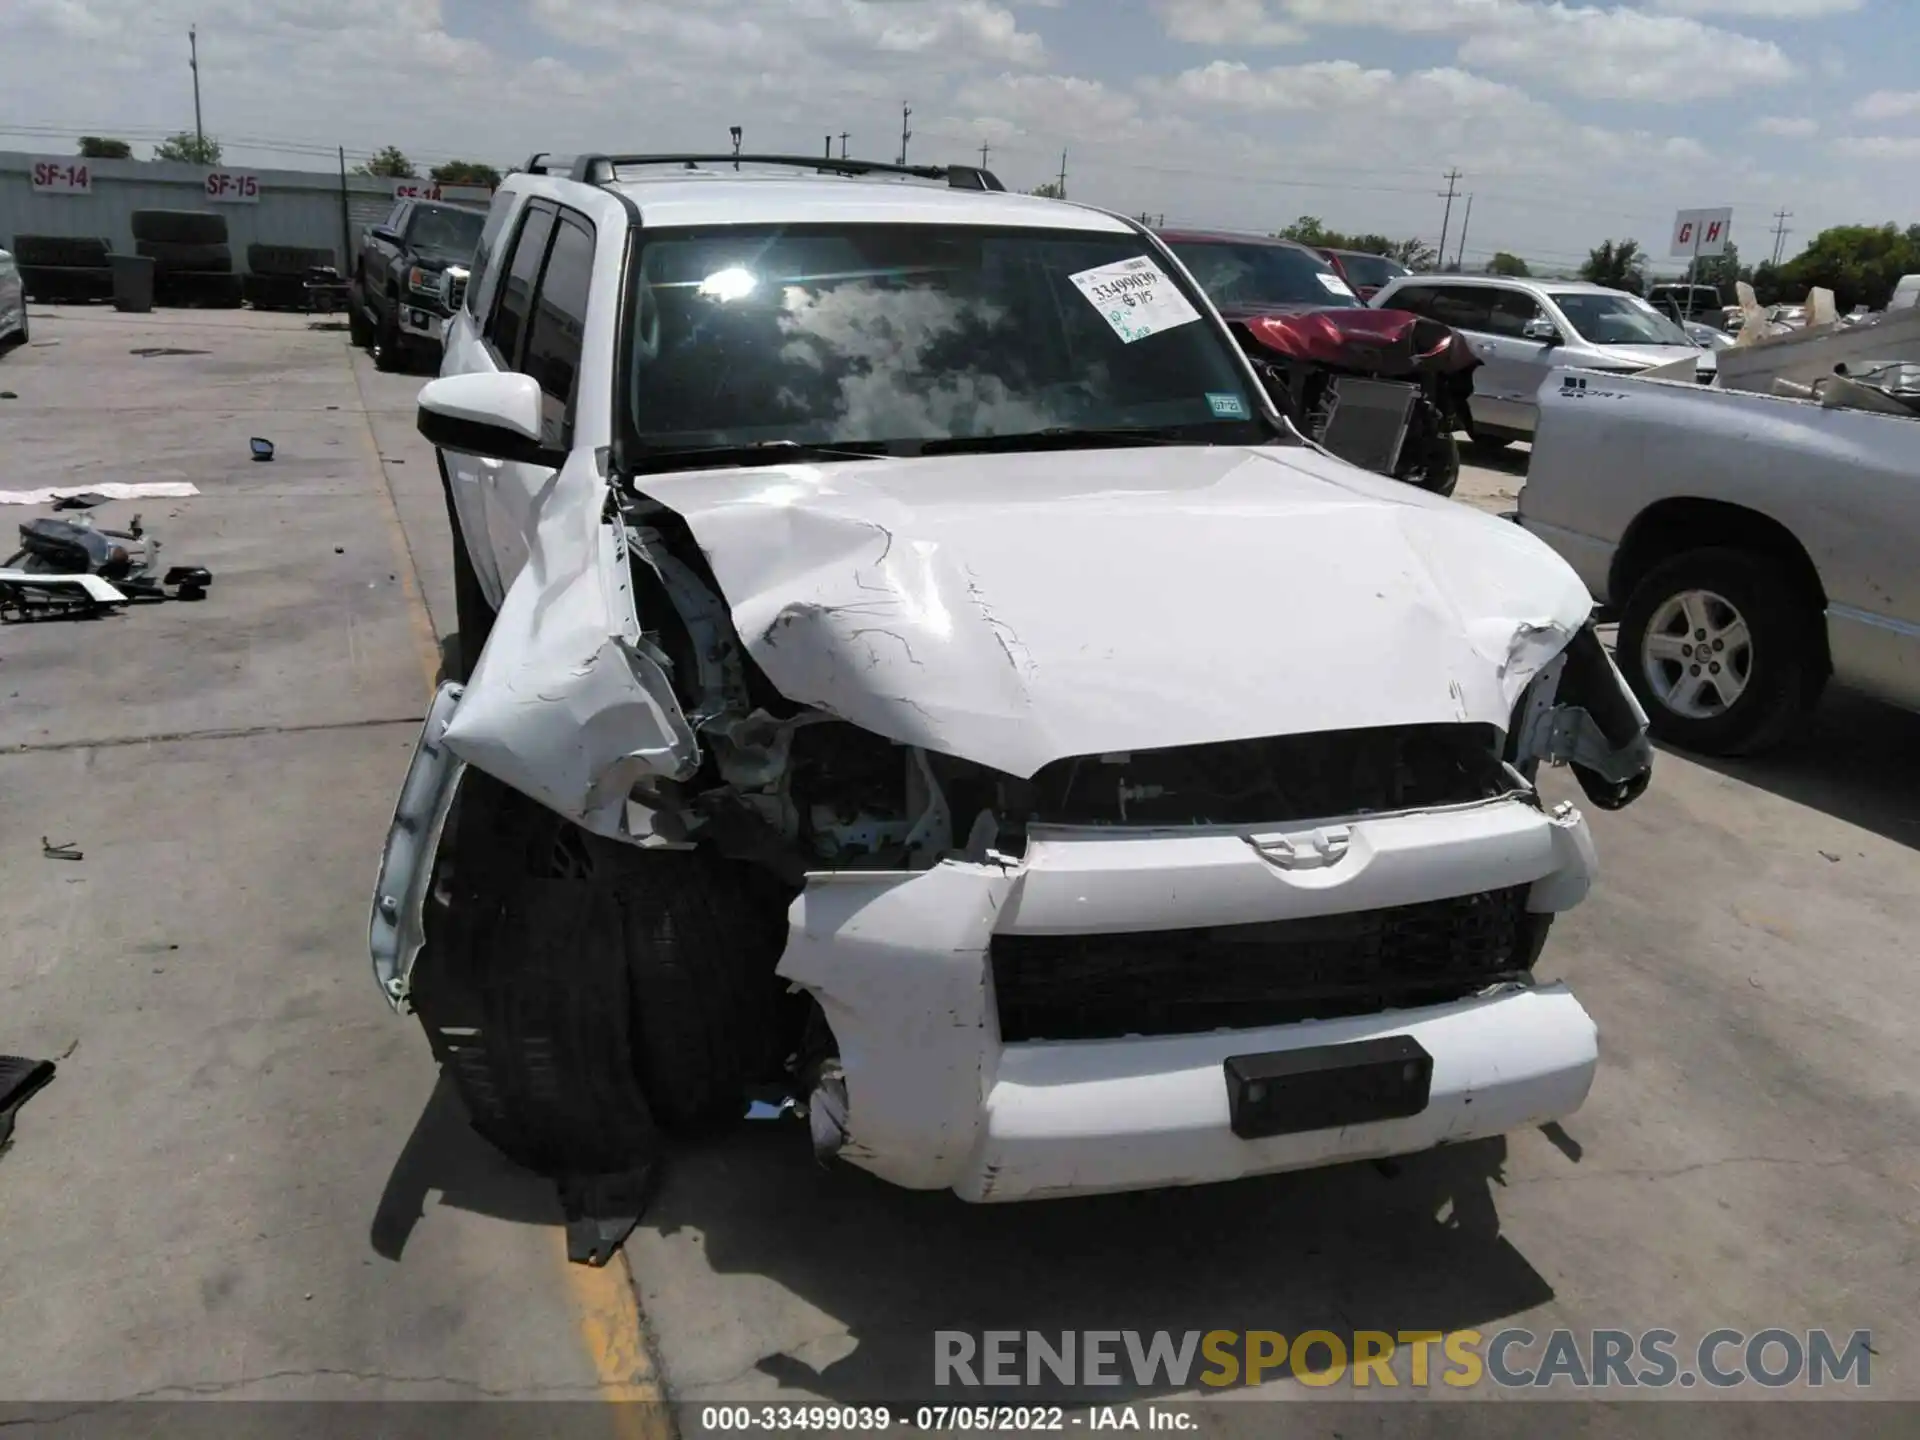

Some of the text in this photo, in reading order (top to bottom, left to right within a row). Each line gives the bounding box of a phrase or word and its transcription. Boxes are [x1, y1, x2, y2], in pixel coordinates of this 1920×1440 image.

[34, 163, 88, 188] SF-14
[207, 173, 258, 197] SF-15
[1679, 221, 1721, 243] G H
[1091, 271, 1157, 301] 33499039
